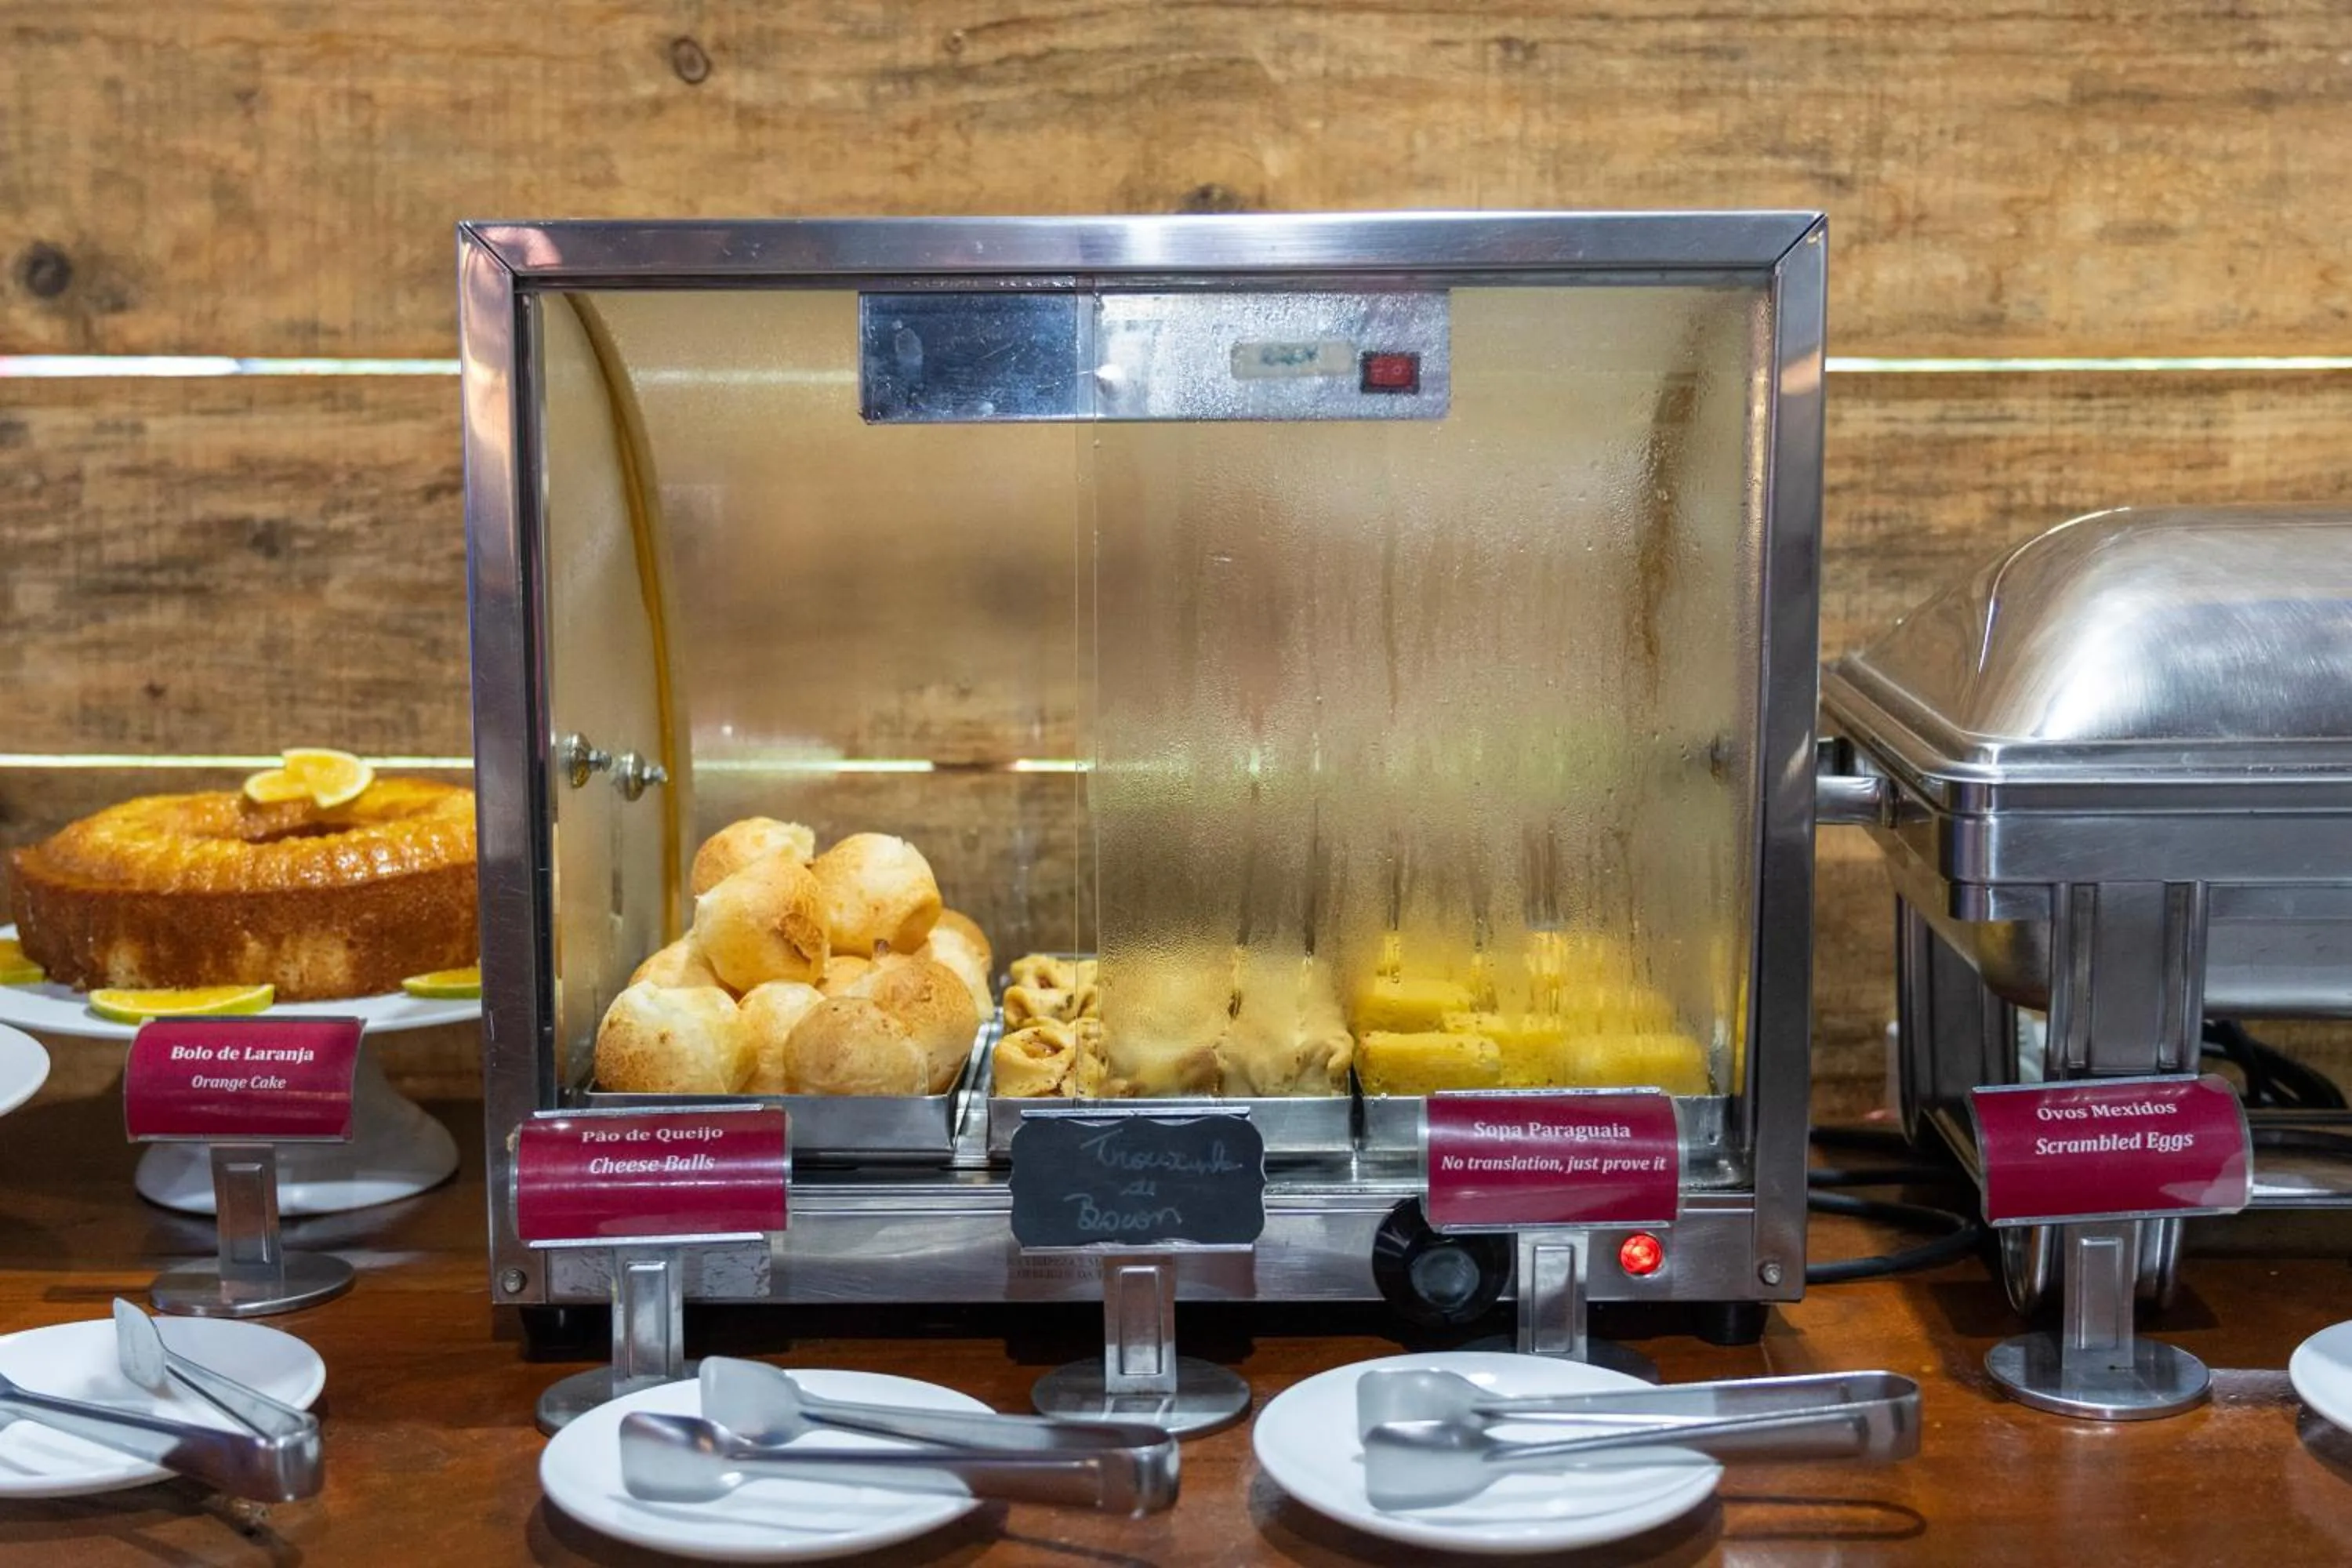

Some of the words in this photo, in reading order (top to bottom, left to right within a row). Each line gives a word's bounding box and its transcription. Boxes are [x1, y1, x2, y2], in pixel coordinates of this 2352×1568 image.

[170, 1045, 213, 1061] Bolo
[217, 1046, 240, 1061] de
[244, 1047, 314, 1065] Laranja
[191, 1075, 248, 1092] Orange
[250, 1076, 287, 1089] Cake
[2037, 1107, 2088, 1121] Ovos
[2090, 1101, 2178, 1118] Mexidos
[582, 1130, 620, 1143] Pão
[626, 1129, 651, 1142] de
[655, 1127, 724, 1143] Queijo
[1473, 1122, 1522, 1141] Sopa
[1528, 1122, 1632, 1142] Paraguaia
[2035, 1132, 2142, 1155] Scrambled
[2147, 1131, 2194, 1152] Eggs
[589, 1156, 661, 1174] Cheese
[662, 1154, 716, 1171] Balls
[1441, 1156, 1464, 1171] No
[1468, 1156, 1564, 1173] translation,
[1565, 1156, 1599, 1174] just
[1601, 1158, 1649, 1174] prove
[1653, 1156, 1667, 1171] it
